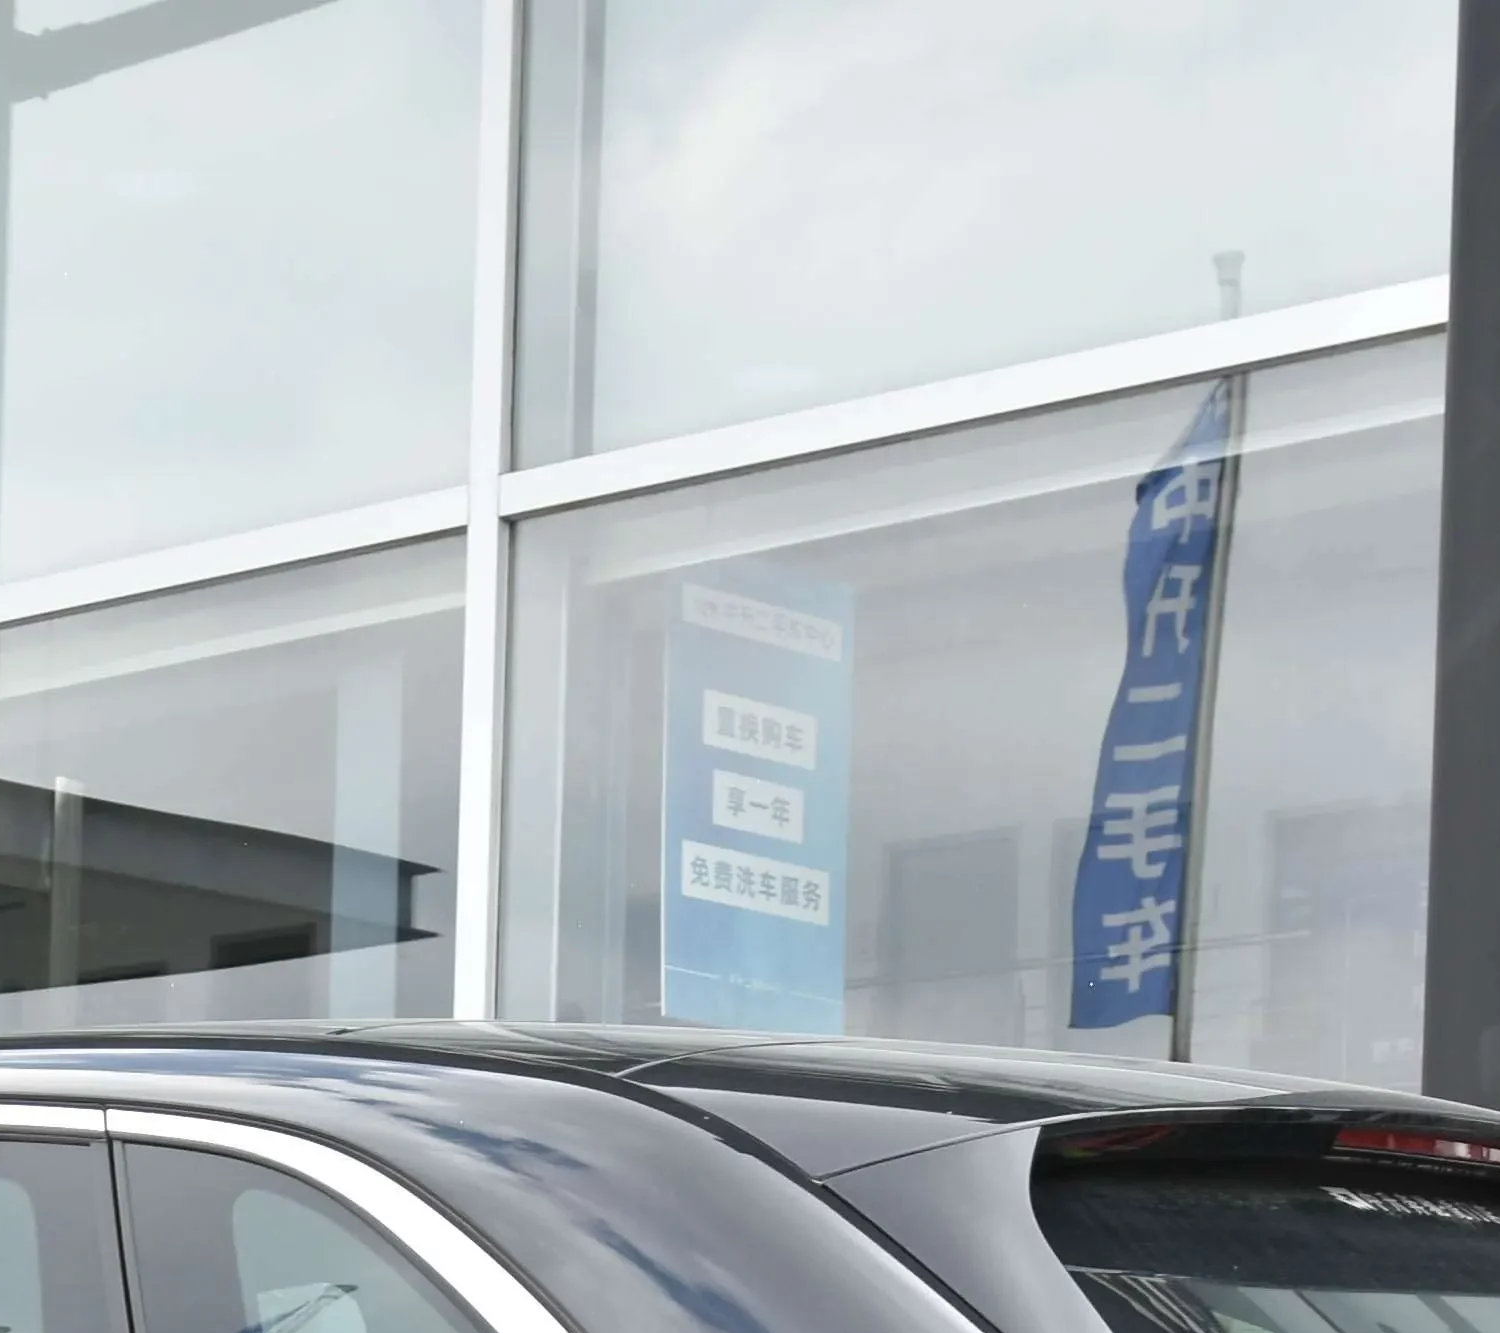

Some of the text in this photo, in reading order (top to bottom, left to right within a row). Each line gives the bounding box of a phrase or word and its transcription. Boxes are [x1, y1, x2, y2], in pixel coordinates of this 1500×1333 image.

[715, 704, 807, 755] 置换购车
[724, 784, 792, 830] 享一年
[689, 854, 823, 914] 免费洗车服务
